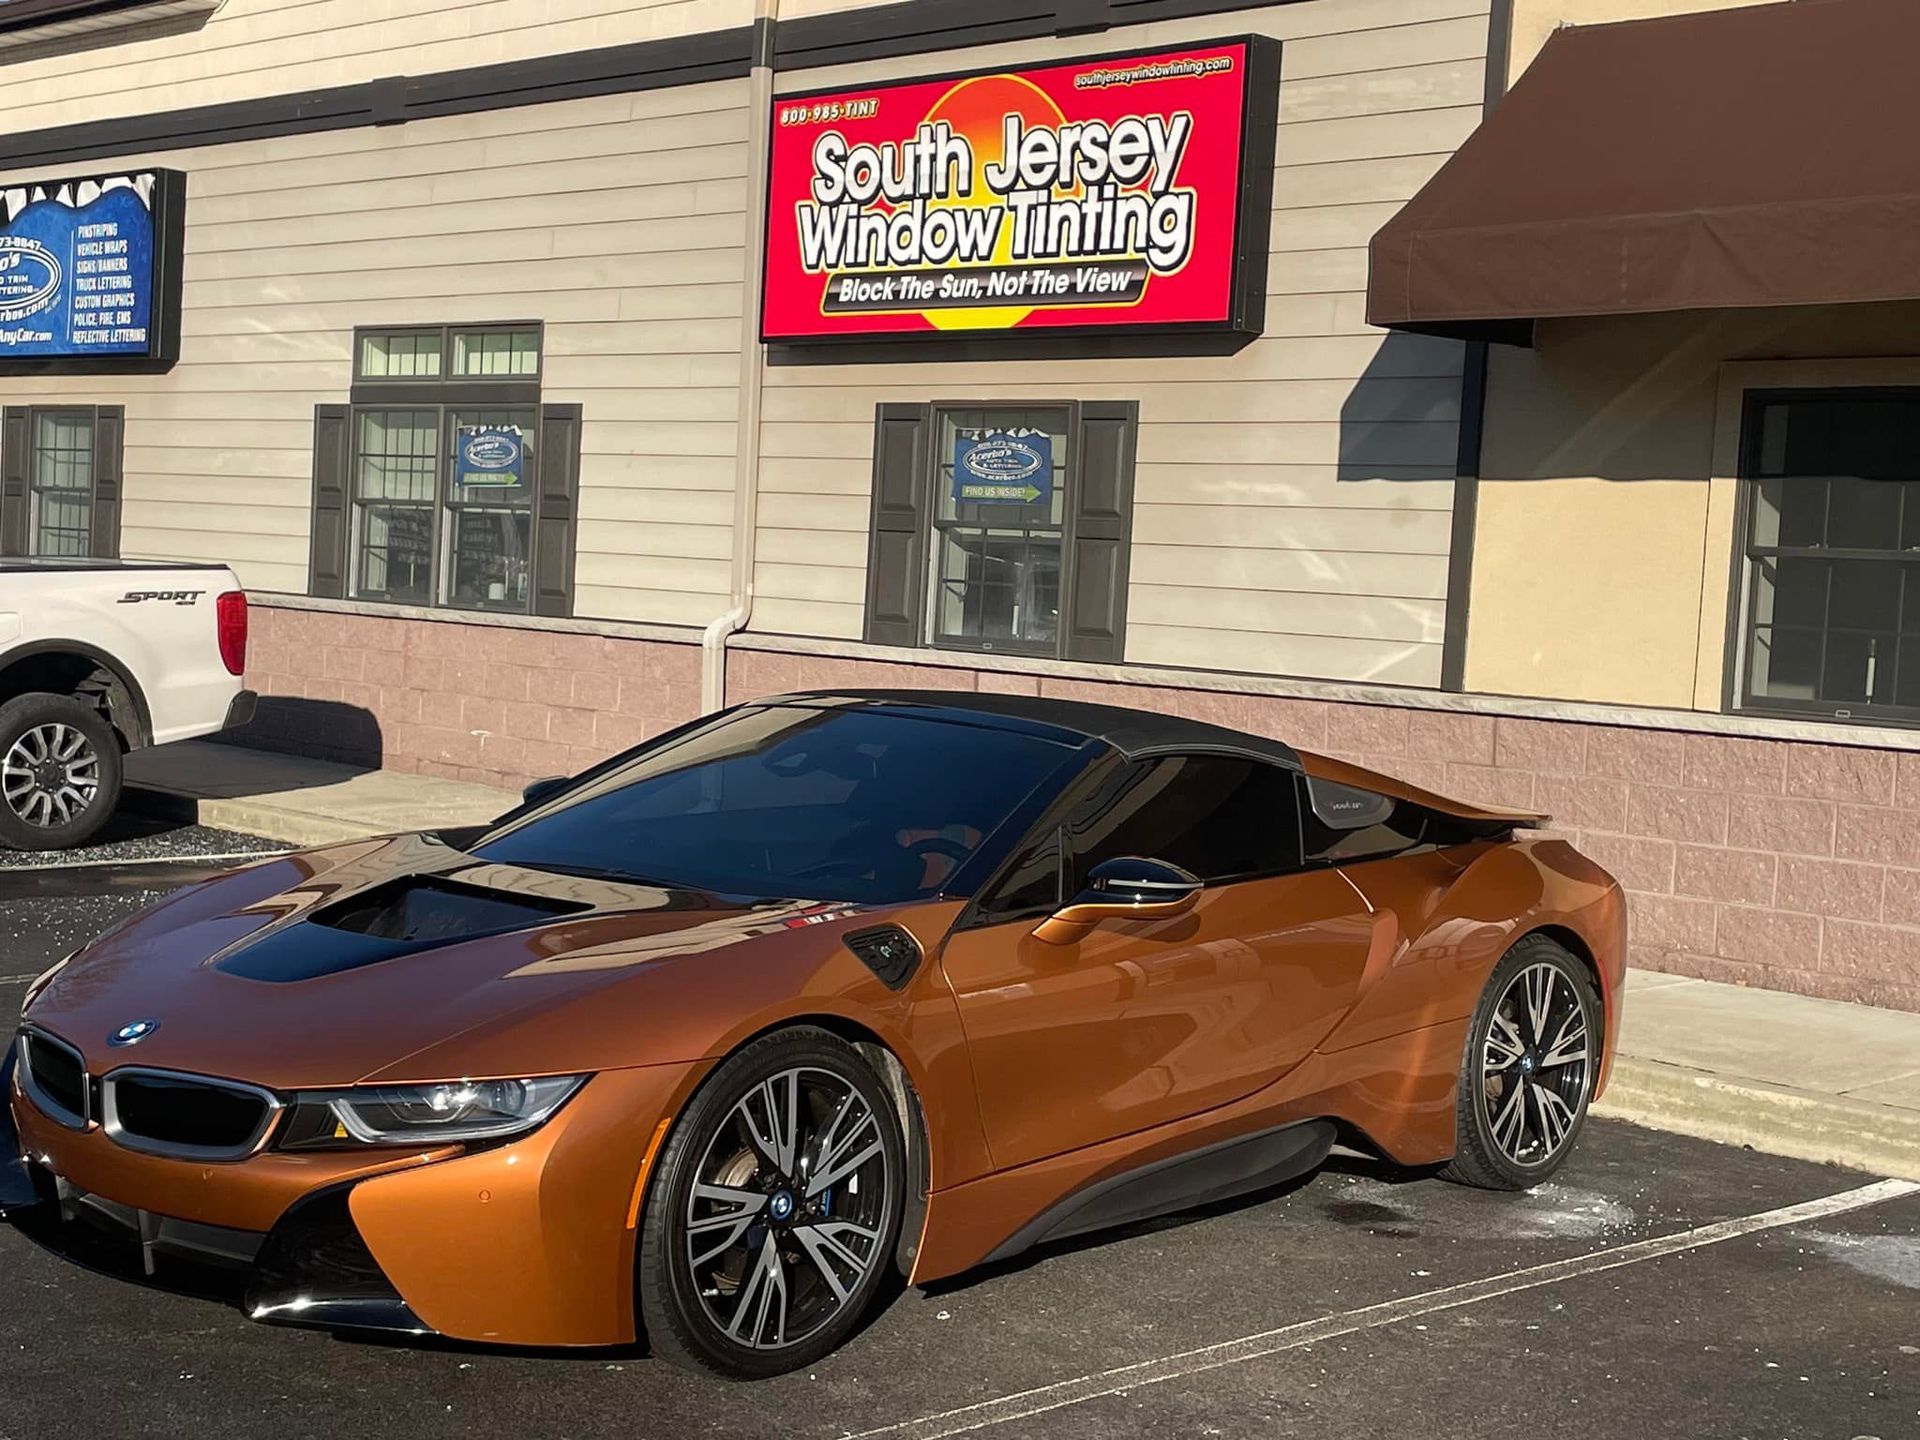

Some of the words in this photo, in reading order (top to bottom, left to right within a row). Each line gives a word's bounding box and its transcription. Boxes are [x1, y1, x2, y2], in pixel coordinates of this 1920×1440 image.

[1075, 57, 1231, 87] southjerseywindowtinting.com
[814, 123, 971, 204] South
[986, 112, 1191, 194] Jersey
[799, 199, 1004, 271] Window
[1006, 184, 1195, 272] Tinting
[77, 242, 104, 257] VEHICLE
[104, 239, 128, 254] WRAPS
[76, 278, 97, 292] TRUCK
[97, 275, 132, 290] LETTERING
[838, 278, 894, 302] Block
[898, 276, 934, 299] The
[938, 273, 983, 299] Sun,
[986, 271, 1027, 296] Not
[1031, 269, 1070, 294] The
[1074, 267, 1132, 293] View
[75, 295, 102, 310] CUSTOM
[102, 292, 135, 308] GRAPHICS
[116, 310, 132, 325] EMS
[73, 329, 110, 344] REFLECTIVE
[110, 328, 147, 343] LETTERING
[965, 486, 984, 497] FIND
[984, 486, 996, 497] US
[116, 591, 207, 604] SPORT
